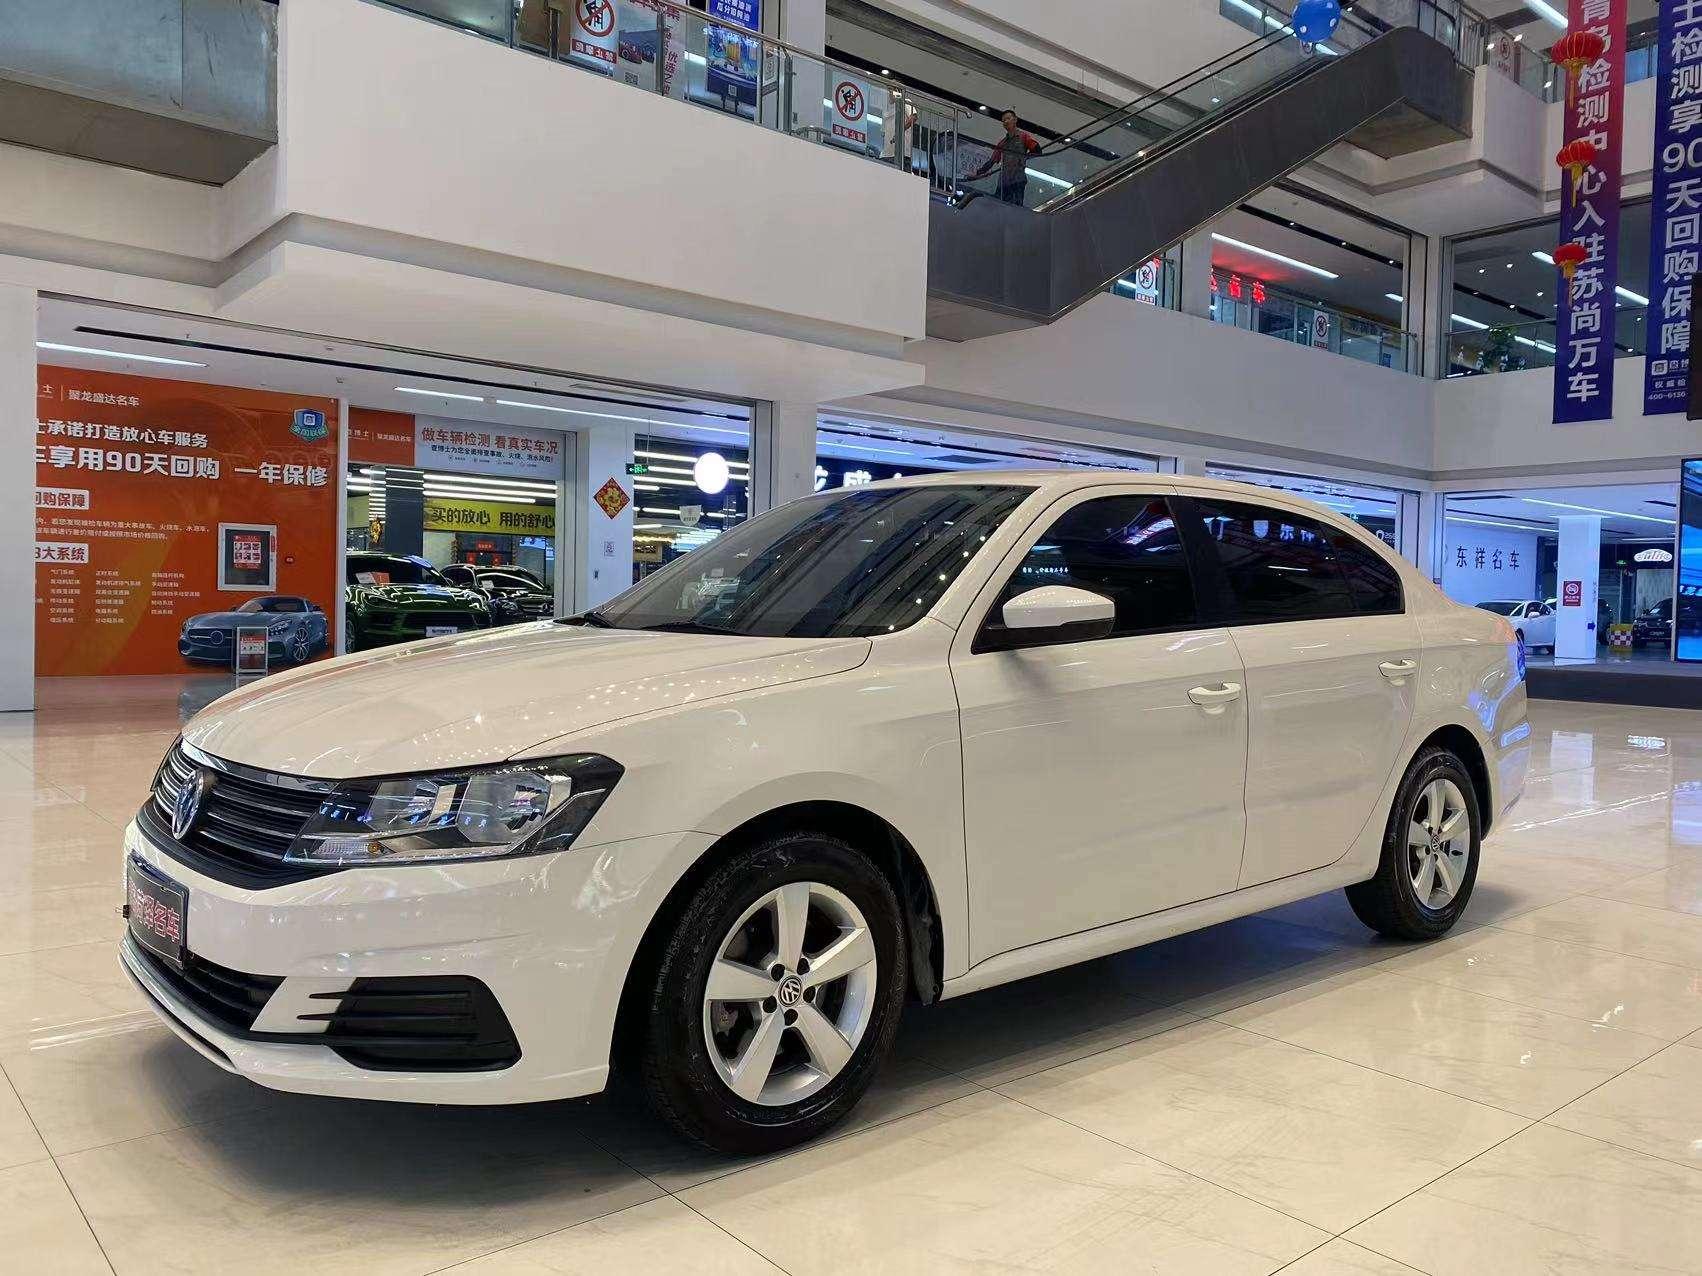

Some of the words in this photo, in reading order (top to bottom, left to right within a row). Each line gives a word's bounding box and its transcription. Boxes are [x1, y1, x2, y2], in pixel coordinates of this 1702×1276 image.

[421, 427, 491, 447] 做车辆检测
[495, 435, 559, 455] 看真实车况
[234, 462, 328, 487] 一年保修
[431, 507, 491, 526] 买的放心
[499, 510, 555, 529] 用的舒心
[1456, 545, 1520, 571] 东祥名车
